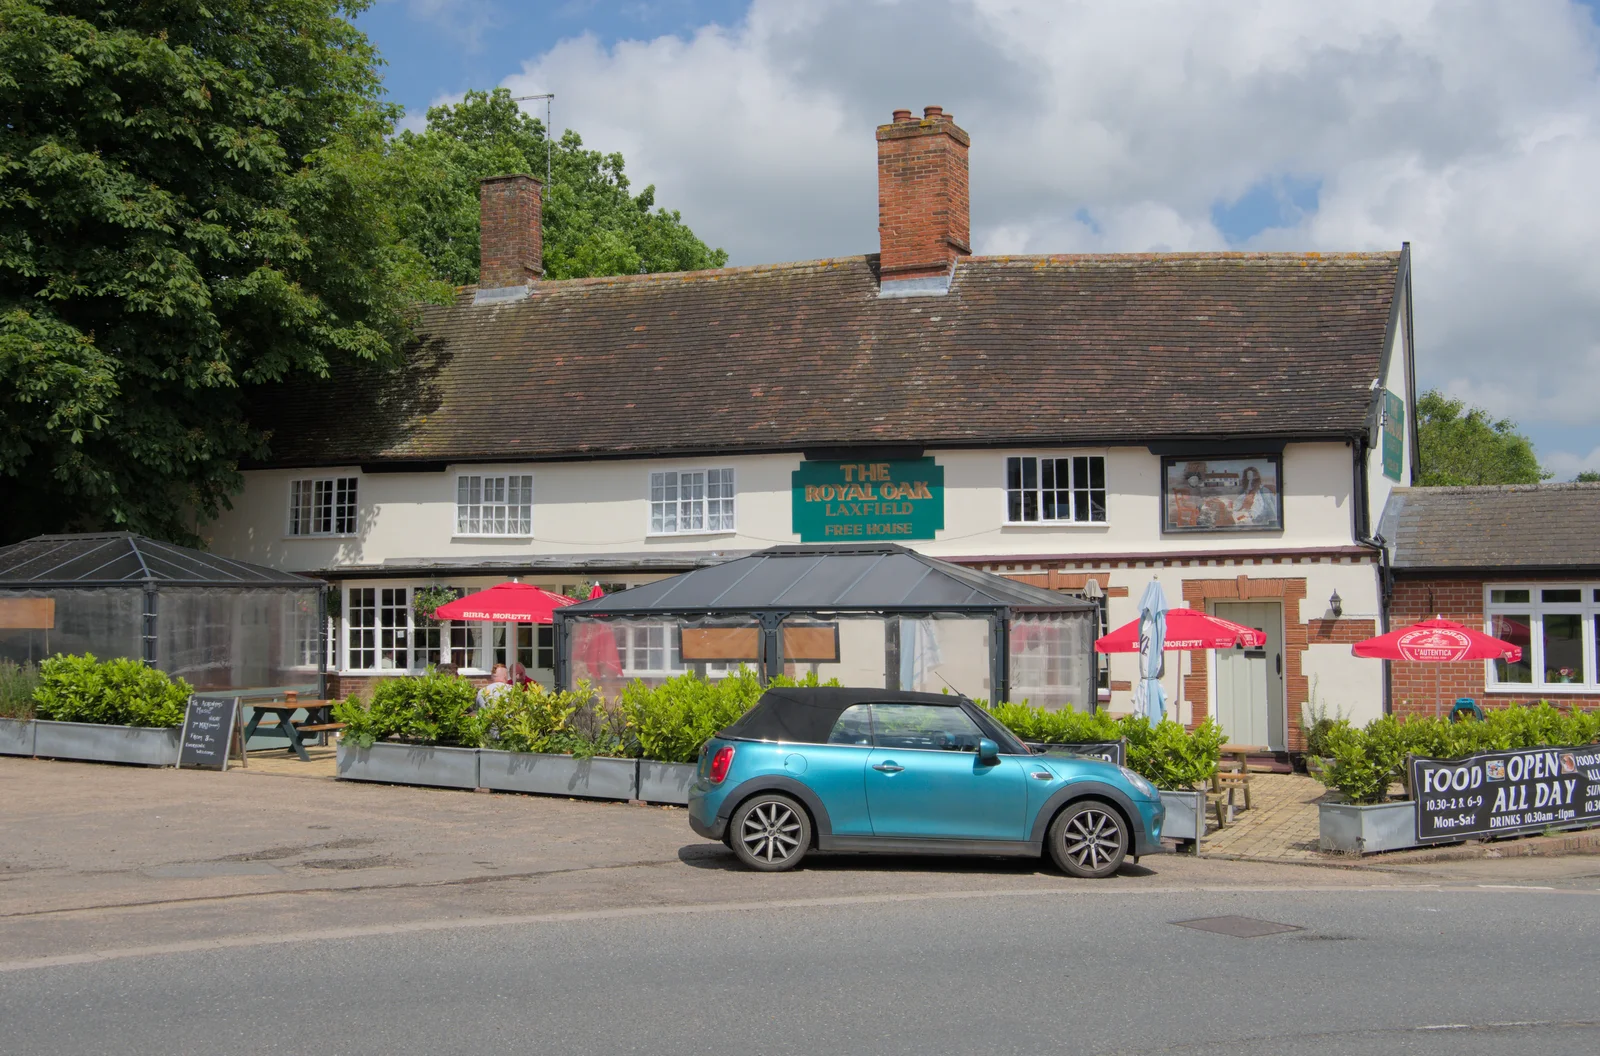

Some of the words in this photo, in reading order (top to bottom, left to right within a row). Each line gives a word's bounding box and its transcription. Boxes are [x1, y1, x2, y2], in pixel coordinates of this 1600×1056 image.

[840, 463, 891, 482] THE
[805, 483, 877, 502] ROYAL
[880, 481, 933, 500] OAK
[825, 502, 913, 516] LAXFIELD
[825, 524, 862, 536] FREE
[866, 523, 913, 535] HOUSE
[463, 611, 490, 619] BIRRA
[492, 612, 531, 620] MORETTI
[1163, 639, 1203, 648] MORETTI
[1414, 648, 1452, 656] L'AUTENTICA
[1507, 752, 1559, 782] OPEN
[1575, 754, 1594, 767] FOOD
[1423, 765, 1483, 793] FOOD
[1426, 797, 1457, 811] 10.30-2
[1458, 797, 1465, 808] &
[1467, 795, 1483, 808] 6-9
[1491, 784, 1529, 813] ALL
[1534, 779, 1577, 808] DAY
[1433, 813, 1476, 829] Mon-Sat
[1489, 813, 1521, 828] DRINKS
[1524, 811, 1553, 824] 10.30am
